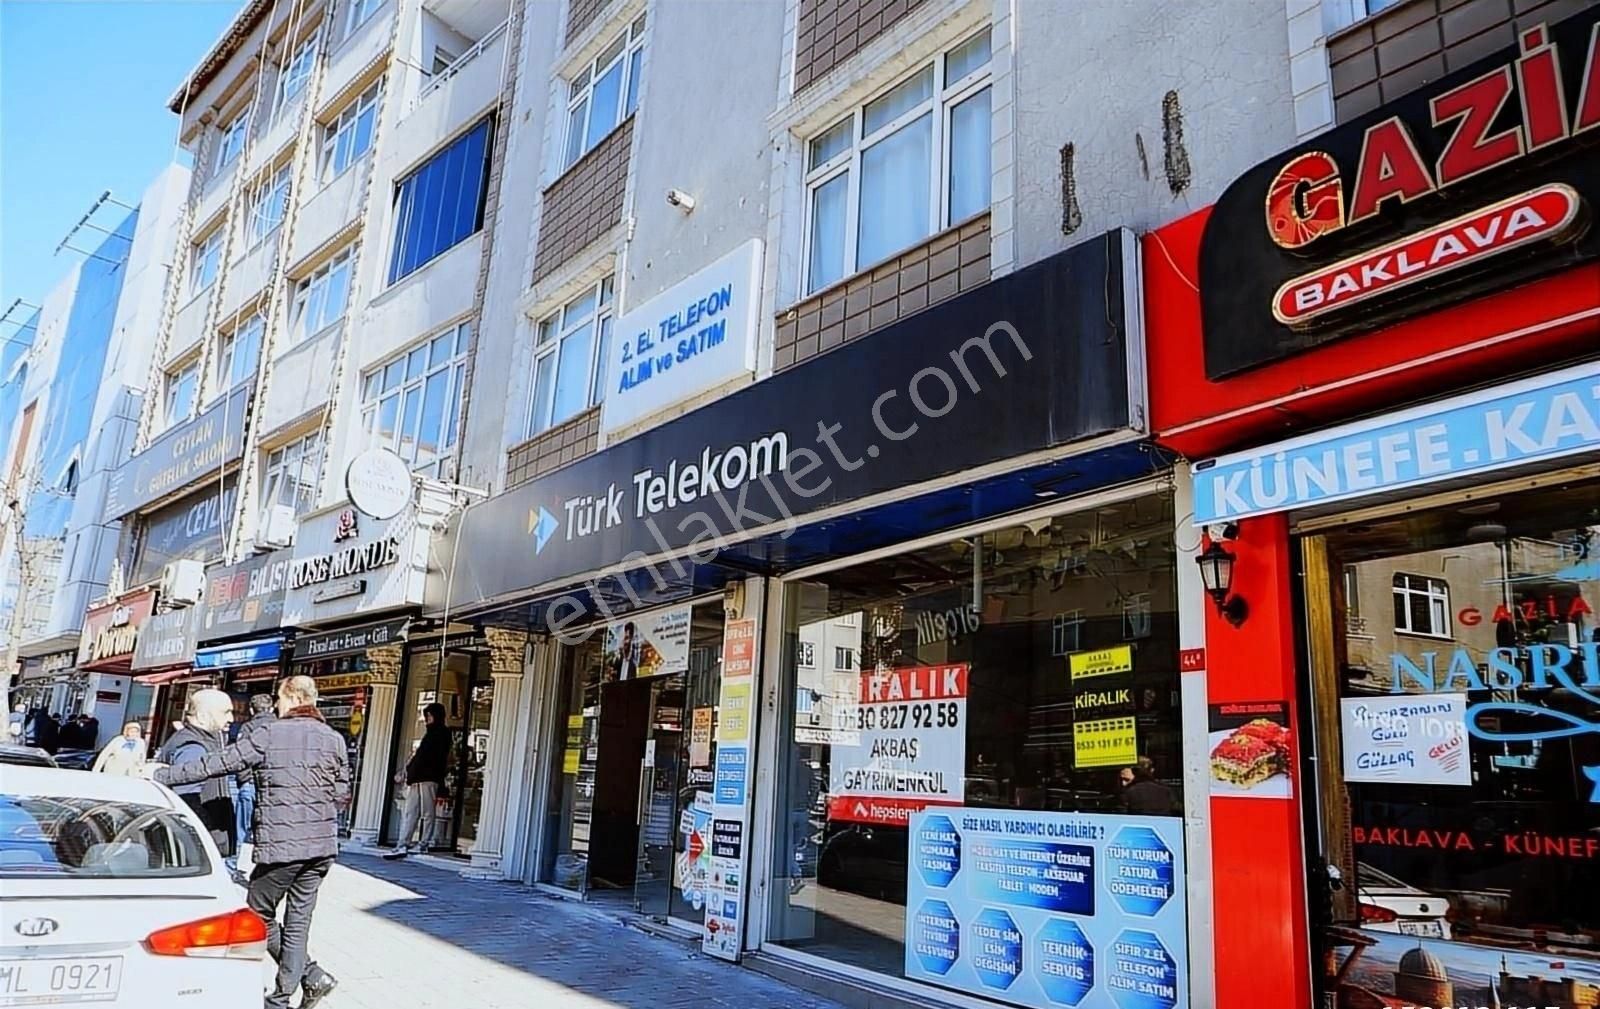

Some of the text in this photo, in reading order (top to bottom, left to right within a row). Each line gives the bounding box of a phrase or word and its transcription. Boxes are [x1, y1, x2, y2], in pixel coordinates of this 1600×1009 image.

[1294, 205, 1547, 312] BAKLAVA
[621, 284, 733, 363] 2. EL TELEFON
[618, 319, 726, 393] ALIM ve SATIM
[564, 431, 789, 541] Türk Telekom
[288, 555, 331, 590] ROSE
[330, 537, 399, 580] MONDE
[344, 632, 366, 648] Event
[372, 625, 389, 643] Gift
[850, 668, 960, 703] İRALIK
[1075, 688, 1130, 709] KİRALIK
[880, 704, 908, 730] 827
[912, 703, 933, 729] 92
[937, 702, 959, 728] 58
[870, 738, 918, 762] AKBAŞ
[962, 814, 979, 831] SİZE
[980, 818, 1002, 833] NASIL
[1004, 820, 1046, 837] YARDIMCI
[1047, 820, 1097, 839] OLABİLİRİZ
[1354, 827, 1475, 851] BAKLAVA
[1108, 845, 1169, 864] TÜM KURUM
[1119, 867, 1158, 881] FATURA
[1112, 880, 1168, 899] ÖDEMELERİ
[19, 917, 56, 936] KIA
[1002, 926, 1020, 943] SİM
[1042, 941, 1083, 960] TEKNİK
[1115, 943, 1141, 957] SIFIR
[50, 963, 112, 991] 0921
[1042, 961, 1083, 981] SERVİS
[1117, 960, 1165, 979] TELEFON
[1110, 976, 1174, 999] ALIM SATIM
